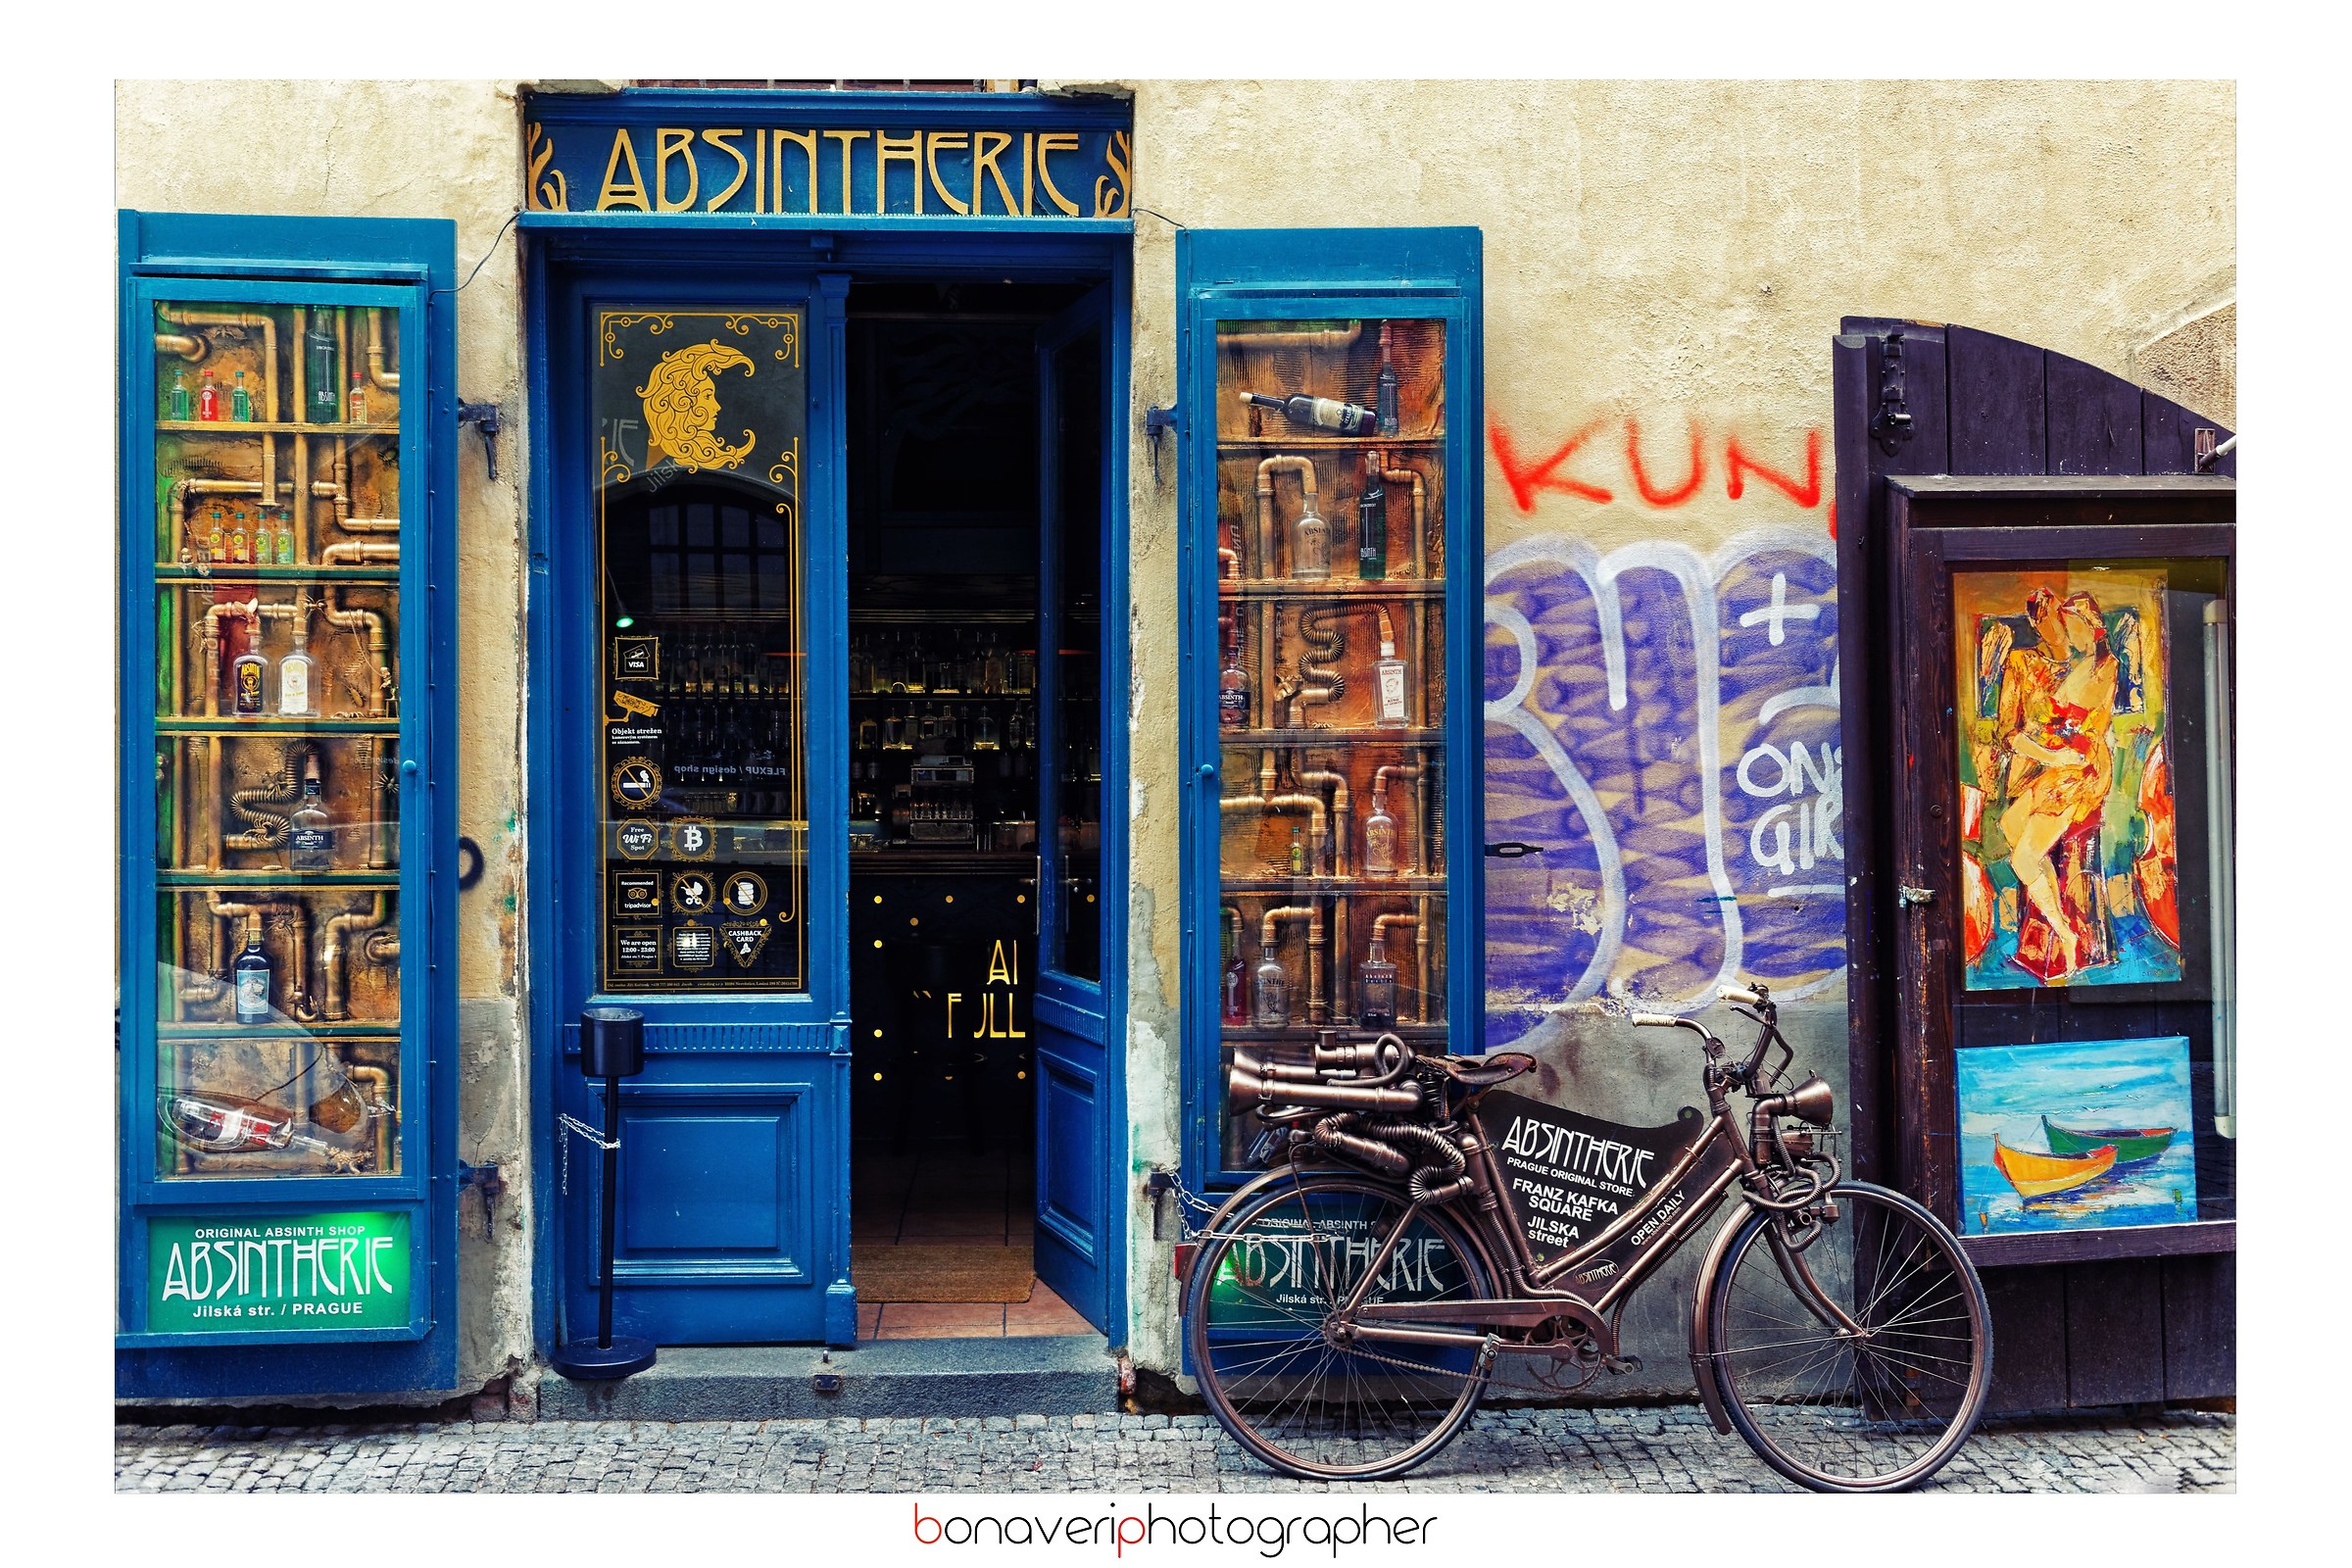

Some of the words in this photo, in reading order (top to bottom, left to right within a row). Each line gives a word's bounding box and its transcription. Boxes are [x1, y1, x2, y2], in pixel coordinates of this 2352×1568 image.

[597, 128, 1079, 218] ABSINTHERIE
[612, 727, 636, 736] Objekt
[1501, 1115, 1655, 1189] ABSINTHERIE
[1506, 1156, 1549, 1175] PRAGUE
[1550, 1167, 1597, 1189] ORIGINAL
[1512, 1177, 1565, 1201] FRANZ
[1566, 1191, 1619, 1215] KAFKA
[1528, 1195, 1593, 1222] SQUARE
[195, 1228, 262, 1239] ORIGINAL
[265, 1226, 324, 1238] ABSINTH
[328, 1225, 366, 1236] SHOP
[1527, 1215, 1580, 1239] JILSKA
[1631, 1217, 1660, 1247] OPEN
[1656, 1190, 1686, 1221] DAILY
[1528, 1229, 1569, 1249] street
[162, 1236, 393, 1301] ABSINTHERIE
[192, 1304, 242, 1318] Jilská
[248, 1304, 275, 1316] str.
[280, 1303, 287, 1316] /
[292, 1301, 364, 1315] PRAGUE
[1276, 1294, 1307, 1304] Jilská
